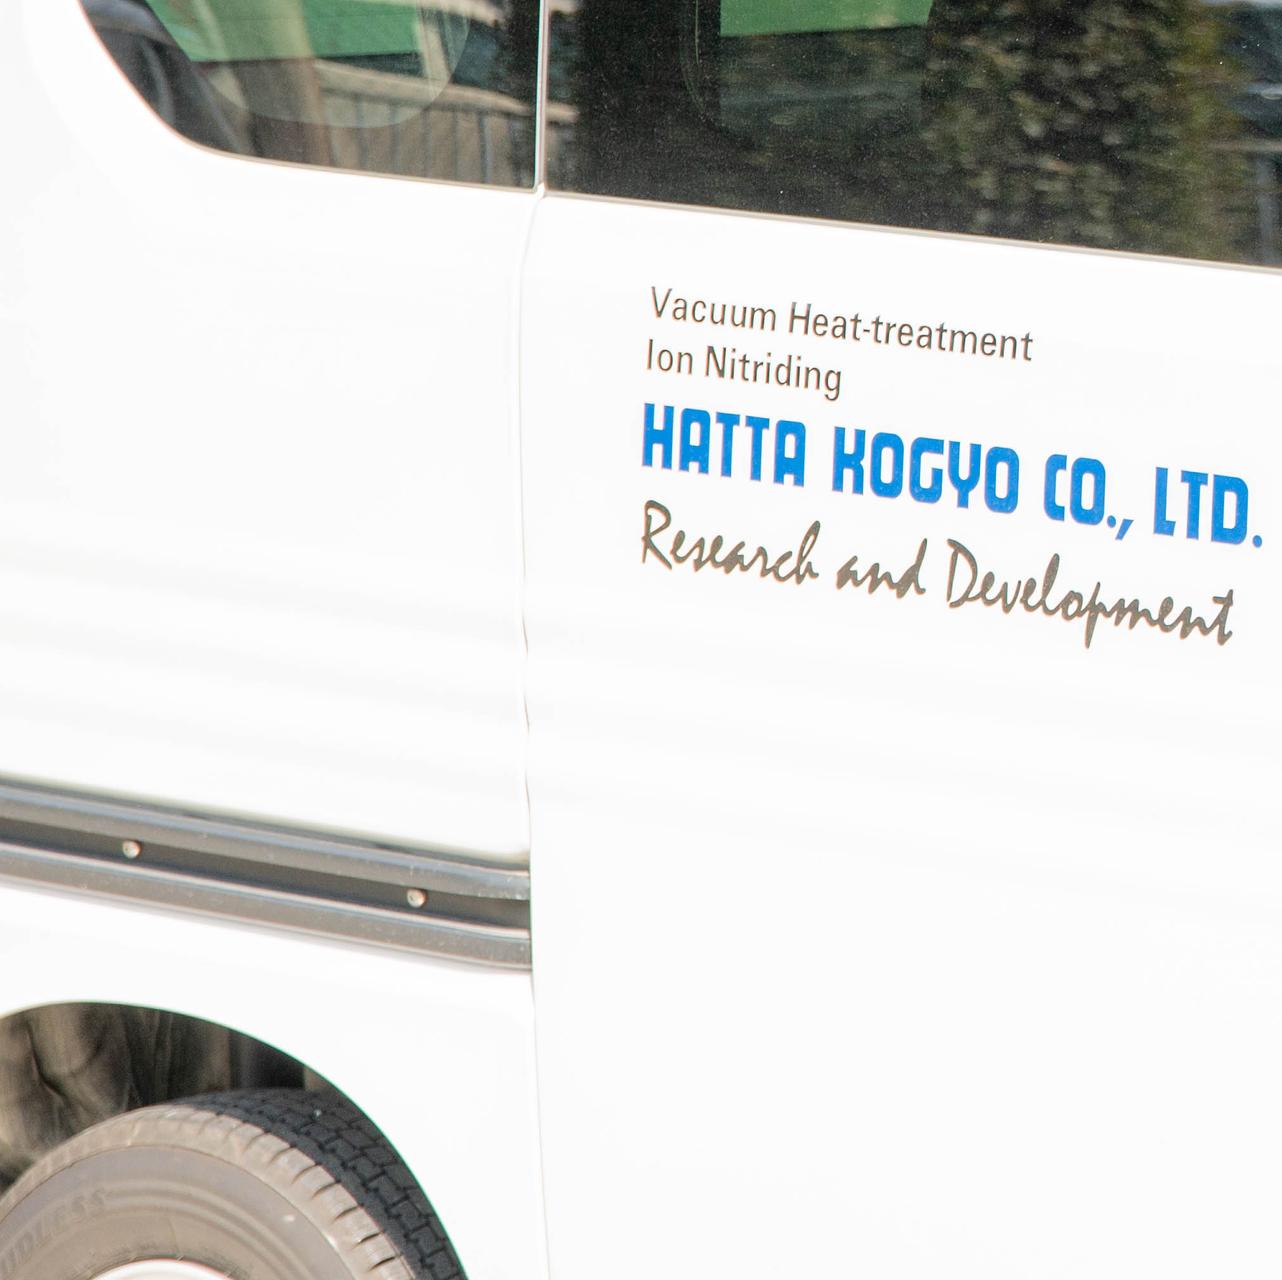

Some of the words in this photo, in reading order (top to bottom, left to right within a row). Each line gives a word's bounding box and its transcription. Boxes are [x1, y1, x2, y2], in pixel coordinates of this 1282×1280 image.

[646, 338, 694, 376] Ion
[704, 345, 842, 402] Nitriding
[651, 285, 777, 332] Vacuum
[788, 301, 1034, 362] Heat-treatment
[641, 402, 807, 488] HATTA
[831, 425, 1021, 515] KOGYO
[1043, 453, 1135, 541] CO.,
[1152, 466, 1263, 549] LTD.
[640, 499, 821, 586] Research
[835, 537, 928, 600] and
[946, 538, 1235, 650] Development
